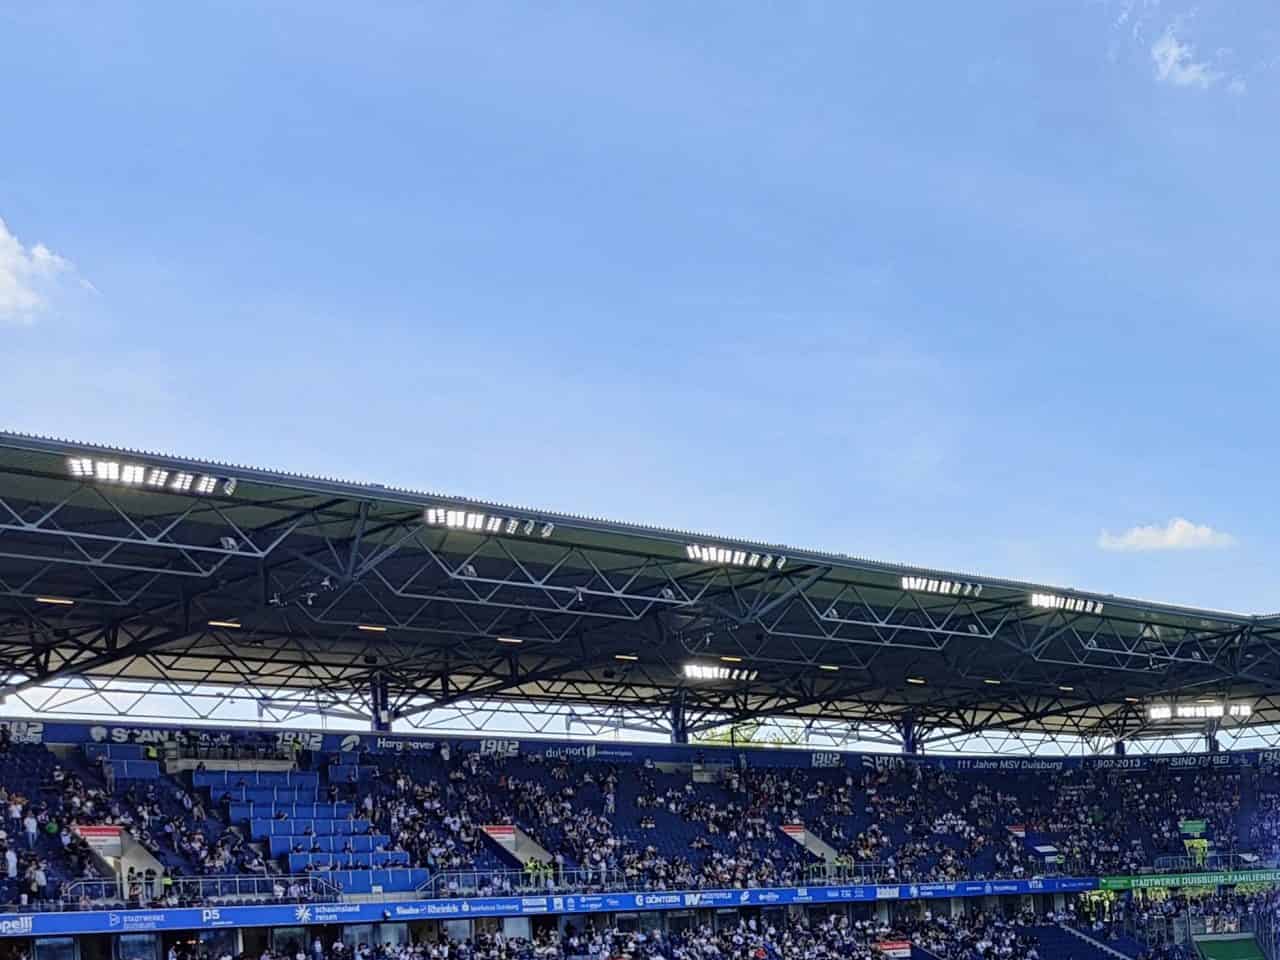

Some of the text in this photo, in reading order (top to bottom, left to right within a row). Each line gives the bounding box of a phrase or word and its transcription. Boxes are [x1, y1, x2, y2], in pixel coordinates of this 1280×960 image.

[377, 737, 434, 751] Hargaves
[972, 760, 998, 769] Jahre
[999, 760, 1020, 769] MSV
[1021, 760, 1063, 770] Duisburg
[203, 909, 220, 922] ps
[0, 916, 32, 933] pelli
